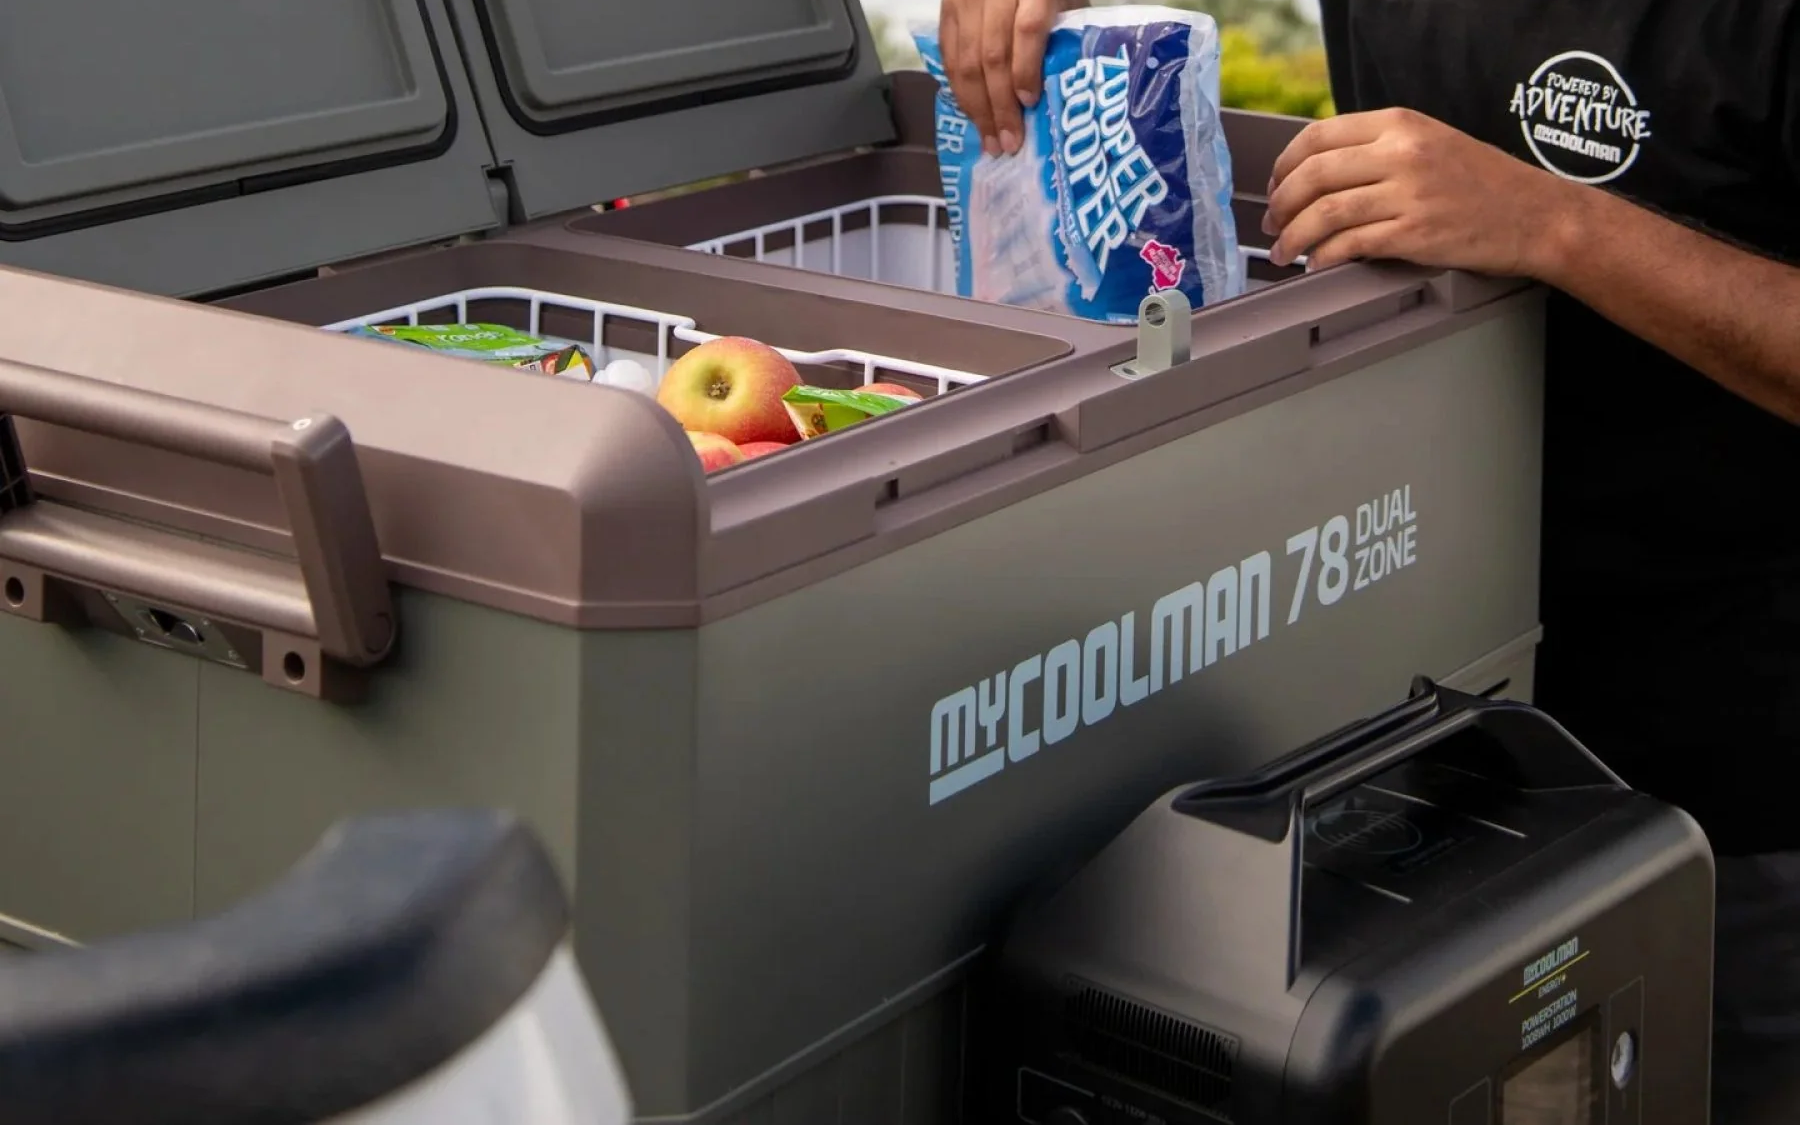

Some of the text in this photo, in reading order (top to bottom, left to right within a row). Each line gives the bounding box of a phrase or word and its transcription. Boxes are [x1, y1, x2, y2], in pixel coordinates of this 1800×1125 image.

[1509, 83, 1652, 141] ADVENTURE
[1547, 72, 1619, 106] POWERED BY
[1060, 58, 1128, 275] DOOPER
[1095, 43, 1168, 229] ZOOPER
[1533, 124, 1622, 164] MYCOOLMAN
[1356, 484, 1417, 545] DUAL
[1353, 525, 1417, 591] ZONE
[929, 515, 1350, 790] MYCOOLMAN 78
[1522, 988, 1577, 1034] POWERSTATION
